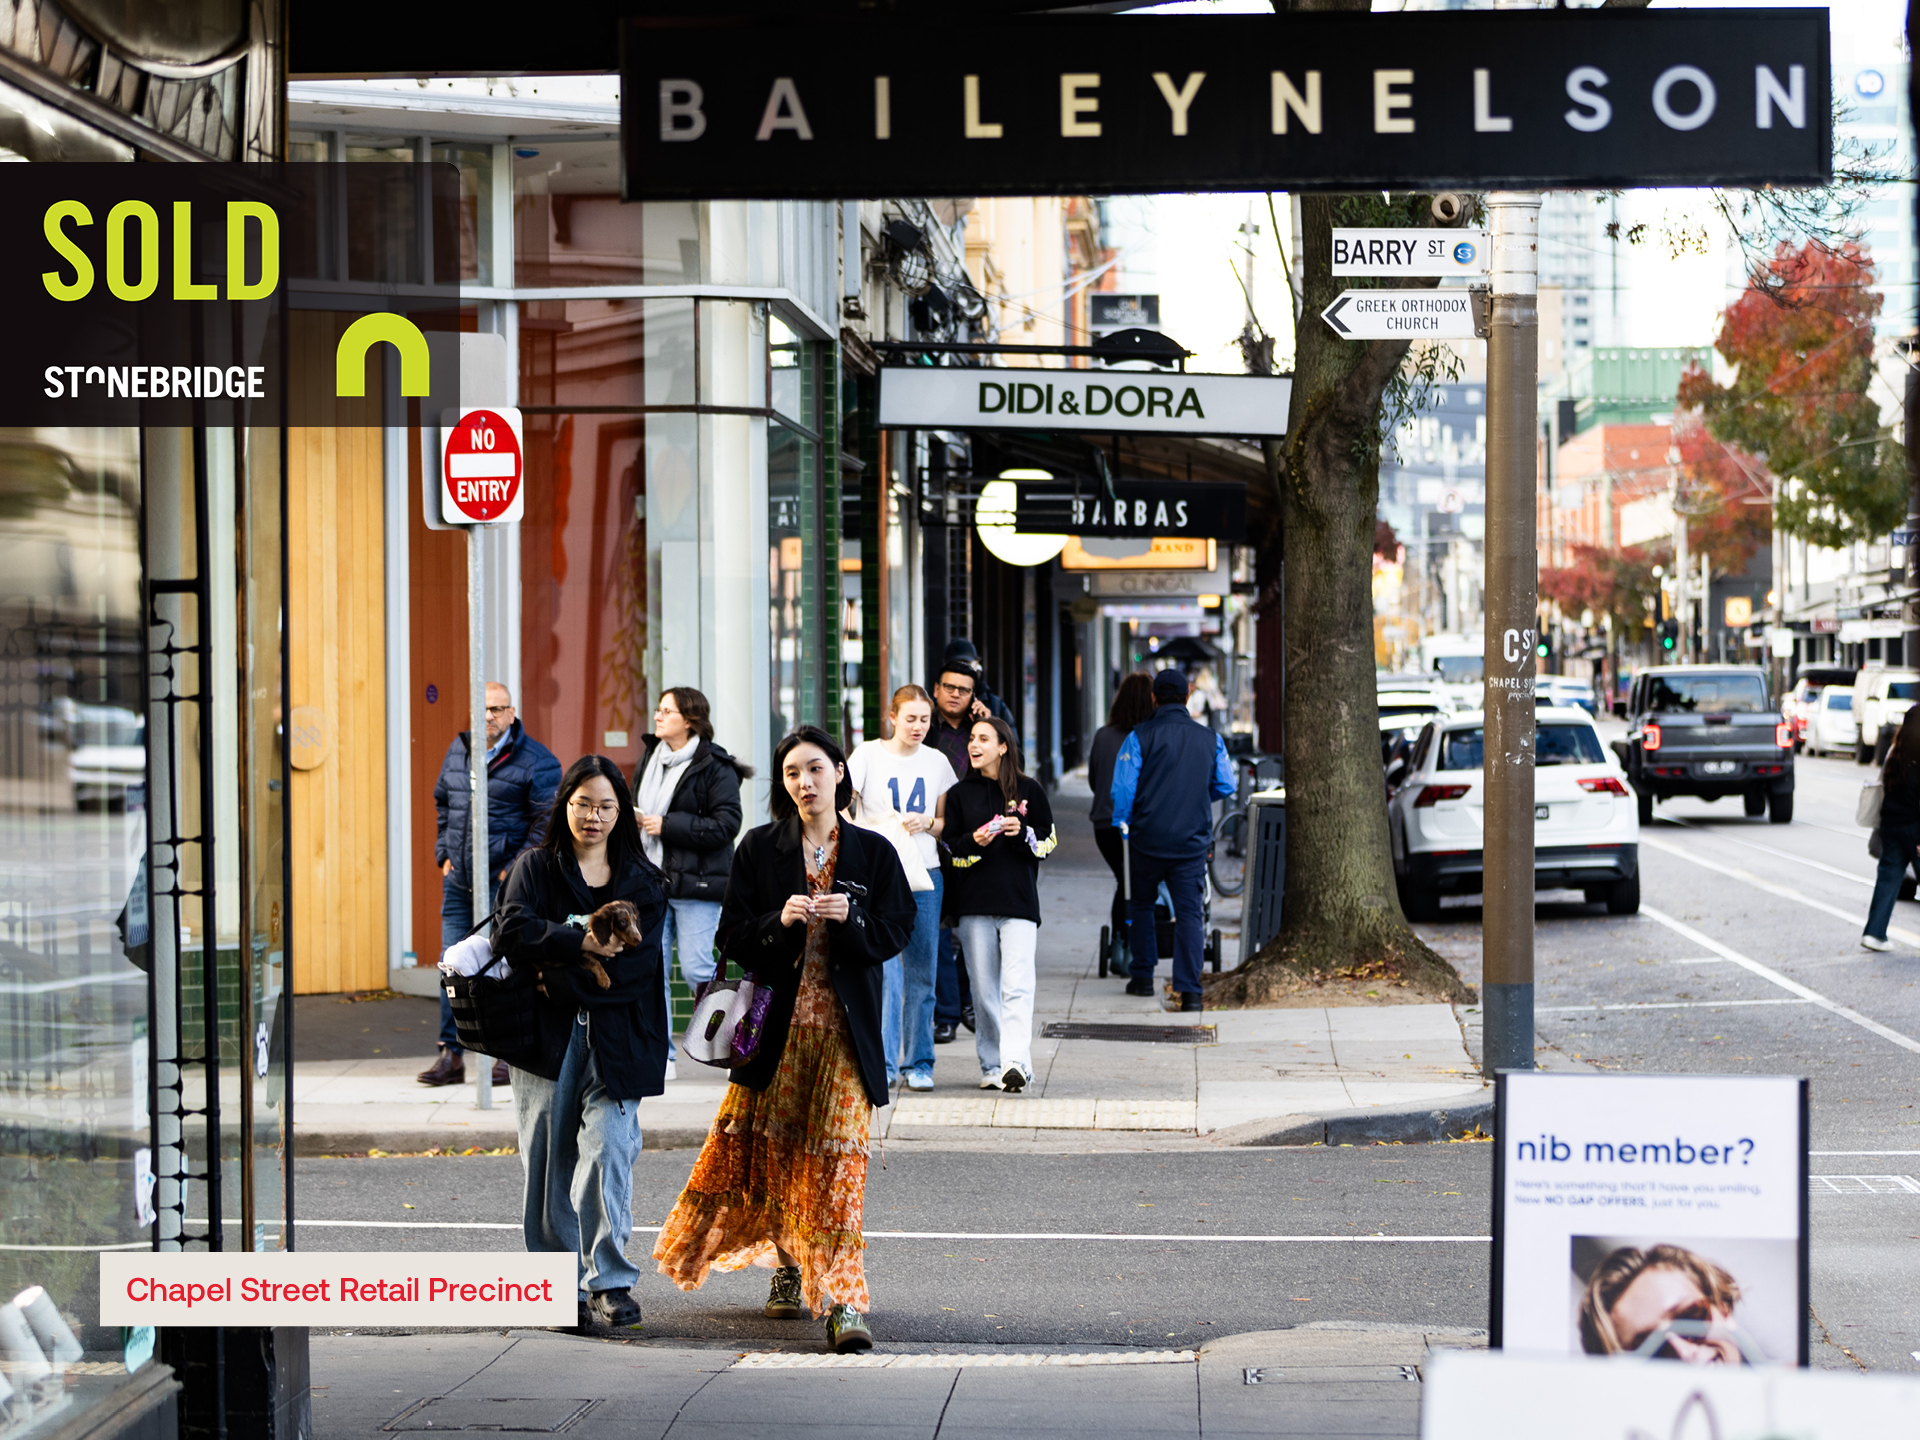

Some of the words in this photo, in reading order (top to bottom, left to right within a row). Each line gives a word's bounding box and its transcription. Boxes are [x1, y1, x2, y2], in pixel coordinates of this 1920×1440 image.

[1334, 239, 1417, 265] BARRY
[1428, 240, 1445, 257] ST
[1356, 300, 1397, 313] GREEK
[1401, 300, 1467, 313] ORTHODOX
[1386, 317, 1439, 330] CHURCH
[978, 382, 1205, 419] DIDI&DORA
[471, 428, 495, 450] NO
[457, 480, 511, 502] ENTRY
[1072, 499, 1188, 527] BARBAS
[1120, 576, 1196, 593] CLINICAL
[1488, 677, 1521, 689] CHAPEL
[887, 777, 926, 814] 14
[1518, 1134, 1571, 1162] nib
[1585, 1137, 1755, 1165] member?
[1554, 1181, 1617, 1193] something
